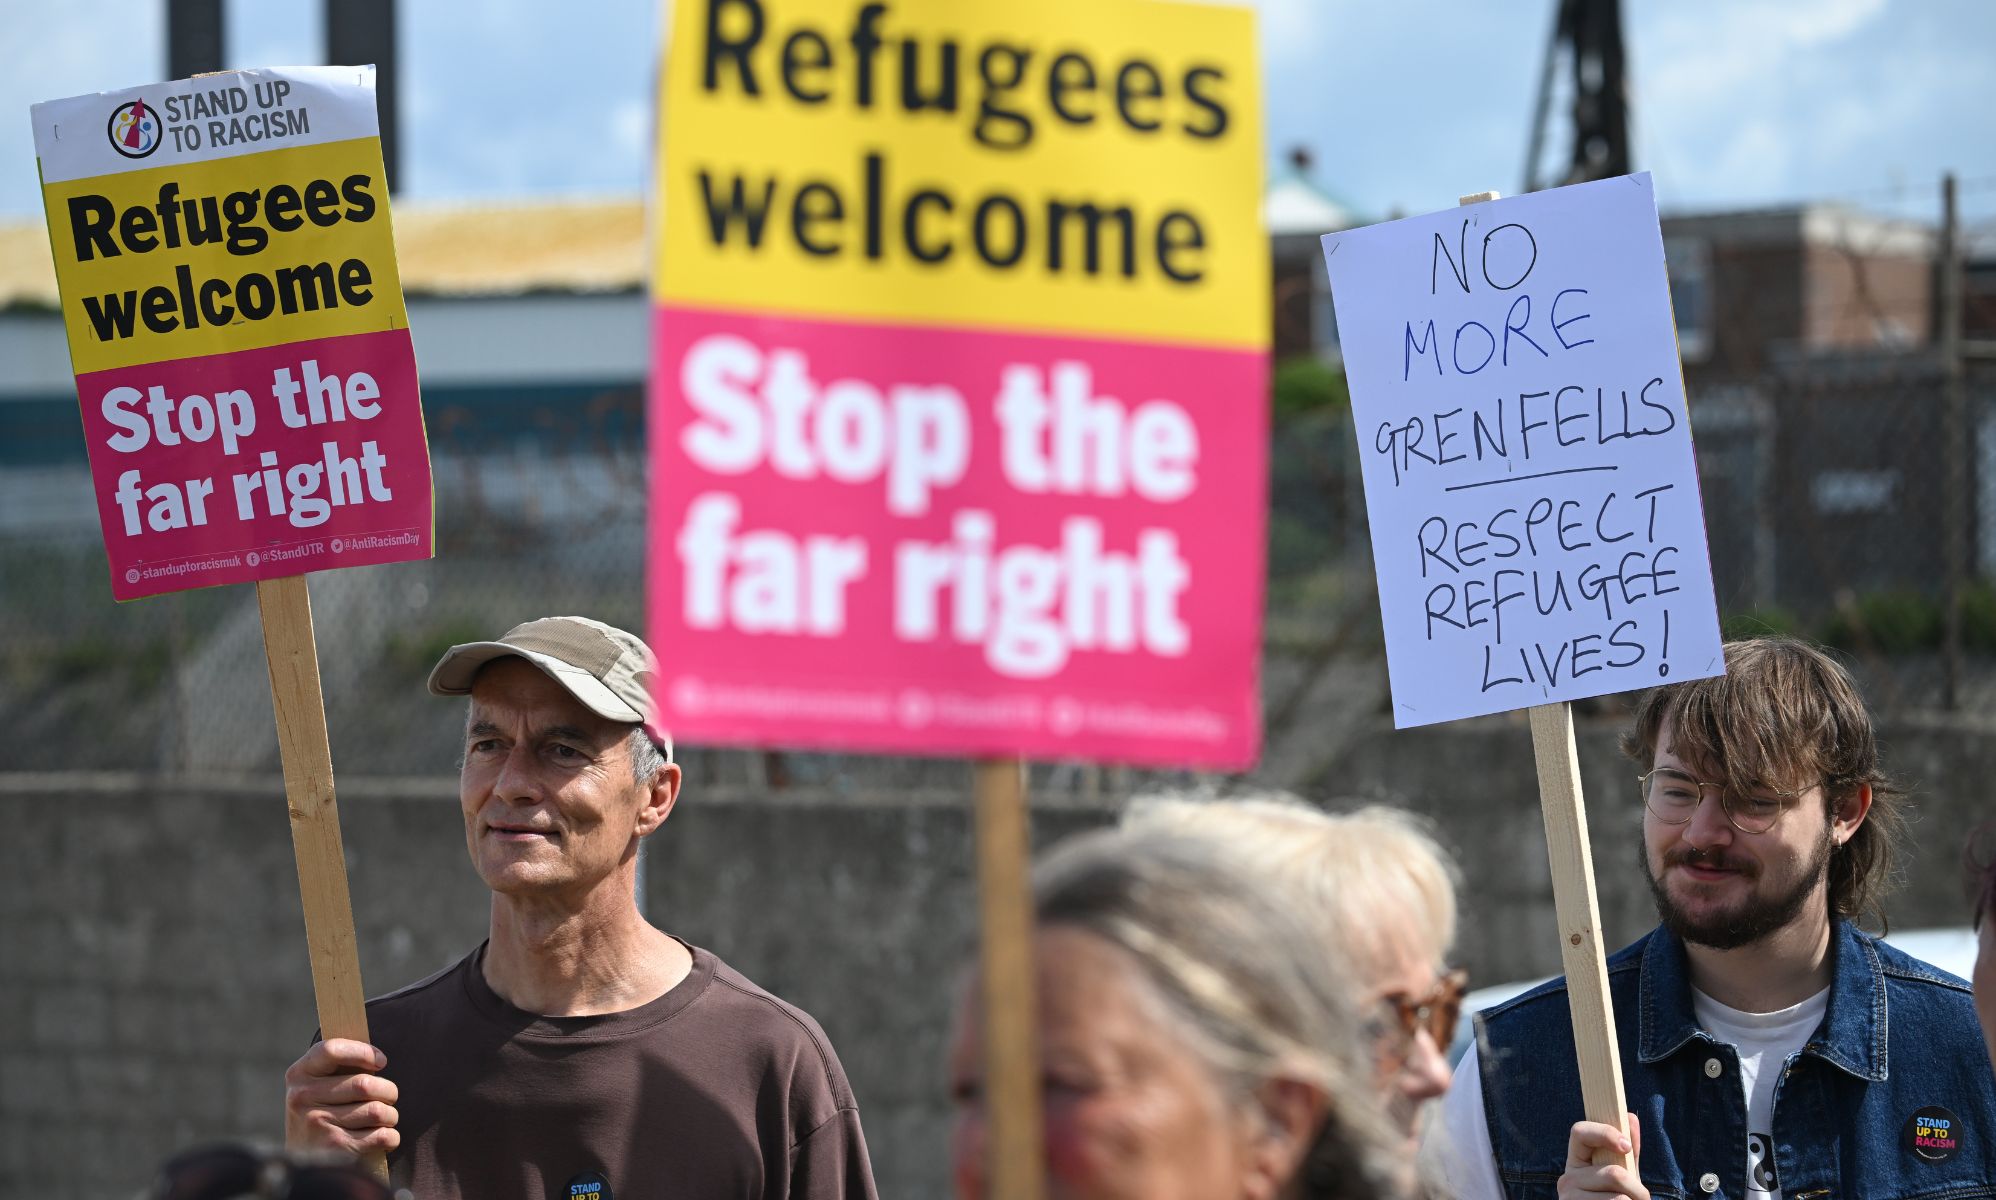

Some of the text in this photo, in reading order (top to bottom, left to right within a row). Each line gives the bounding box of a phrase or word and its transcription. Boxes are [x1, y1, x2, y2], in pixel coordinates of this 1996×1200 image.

[164, 80, 291, 122] STAND UP
[698, 0, 1231, 151] Refugees
[168, 107, 310, 152] TO RACISM
[67, 174, 376, 262] Refugees
[696, 150, 1209, 286] welcome
[1432, 219, 1537, 294] NO
[82, 257, 373, 342] welcome
[1404, 288, 1594, 381] MORE
[101, 359, 383, 456] Stop the
[680, 333, 1200, 517] Stop the
[1375, 377, 1675, 487] GRENFELLS
[115, 440, 393, 537] far right
[1418, 484, 1674, 578] RESPECT
[142, 532, 420, 580] standuptoracismuk @StandUTR @AntiRacismDay
[677, 493, 1192, 680] far right
[1425, 546, 1679, 644] REFUGEE
[1482, 609, 1669, 693] LIVES!
[1915, 1136, 1956, 1149] RACISM
[1916, 1117, 1950, 1129] STAND
[1916, 1127, 1948, 1139] UP TO
[570, 1182, 601, 1195] STAND
